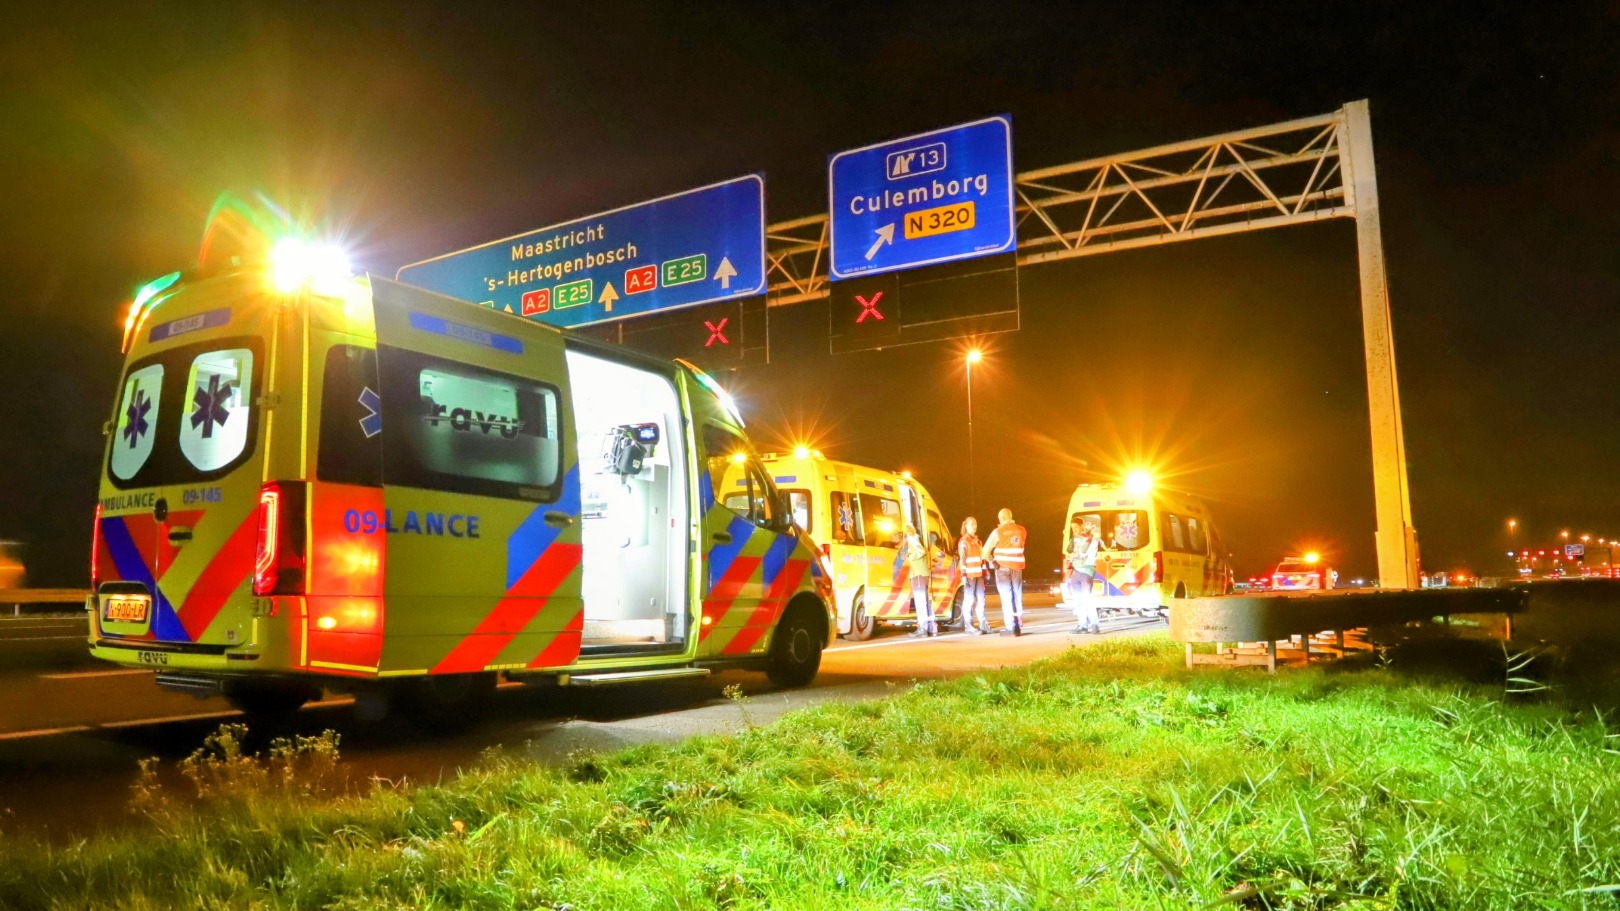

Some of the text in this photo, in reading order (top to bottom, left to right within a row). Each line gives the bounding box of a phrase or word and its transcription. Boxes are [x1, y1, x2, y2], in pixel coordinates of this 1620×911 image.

[919, 150, 939, 168] 13
[850, 174, 988, 215] Culemborg
[511, 223, 604, 261] Maastricht
[484, 242, 637, 292] 's-Hertogenbosch
[430, 403, 519, 440] ravu
[183, 487, 222, 504] 09-145
